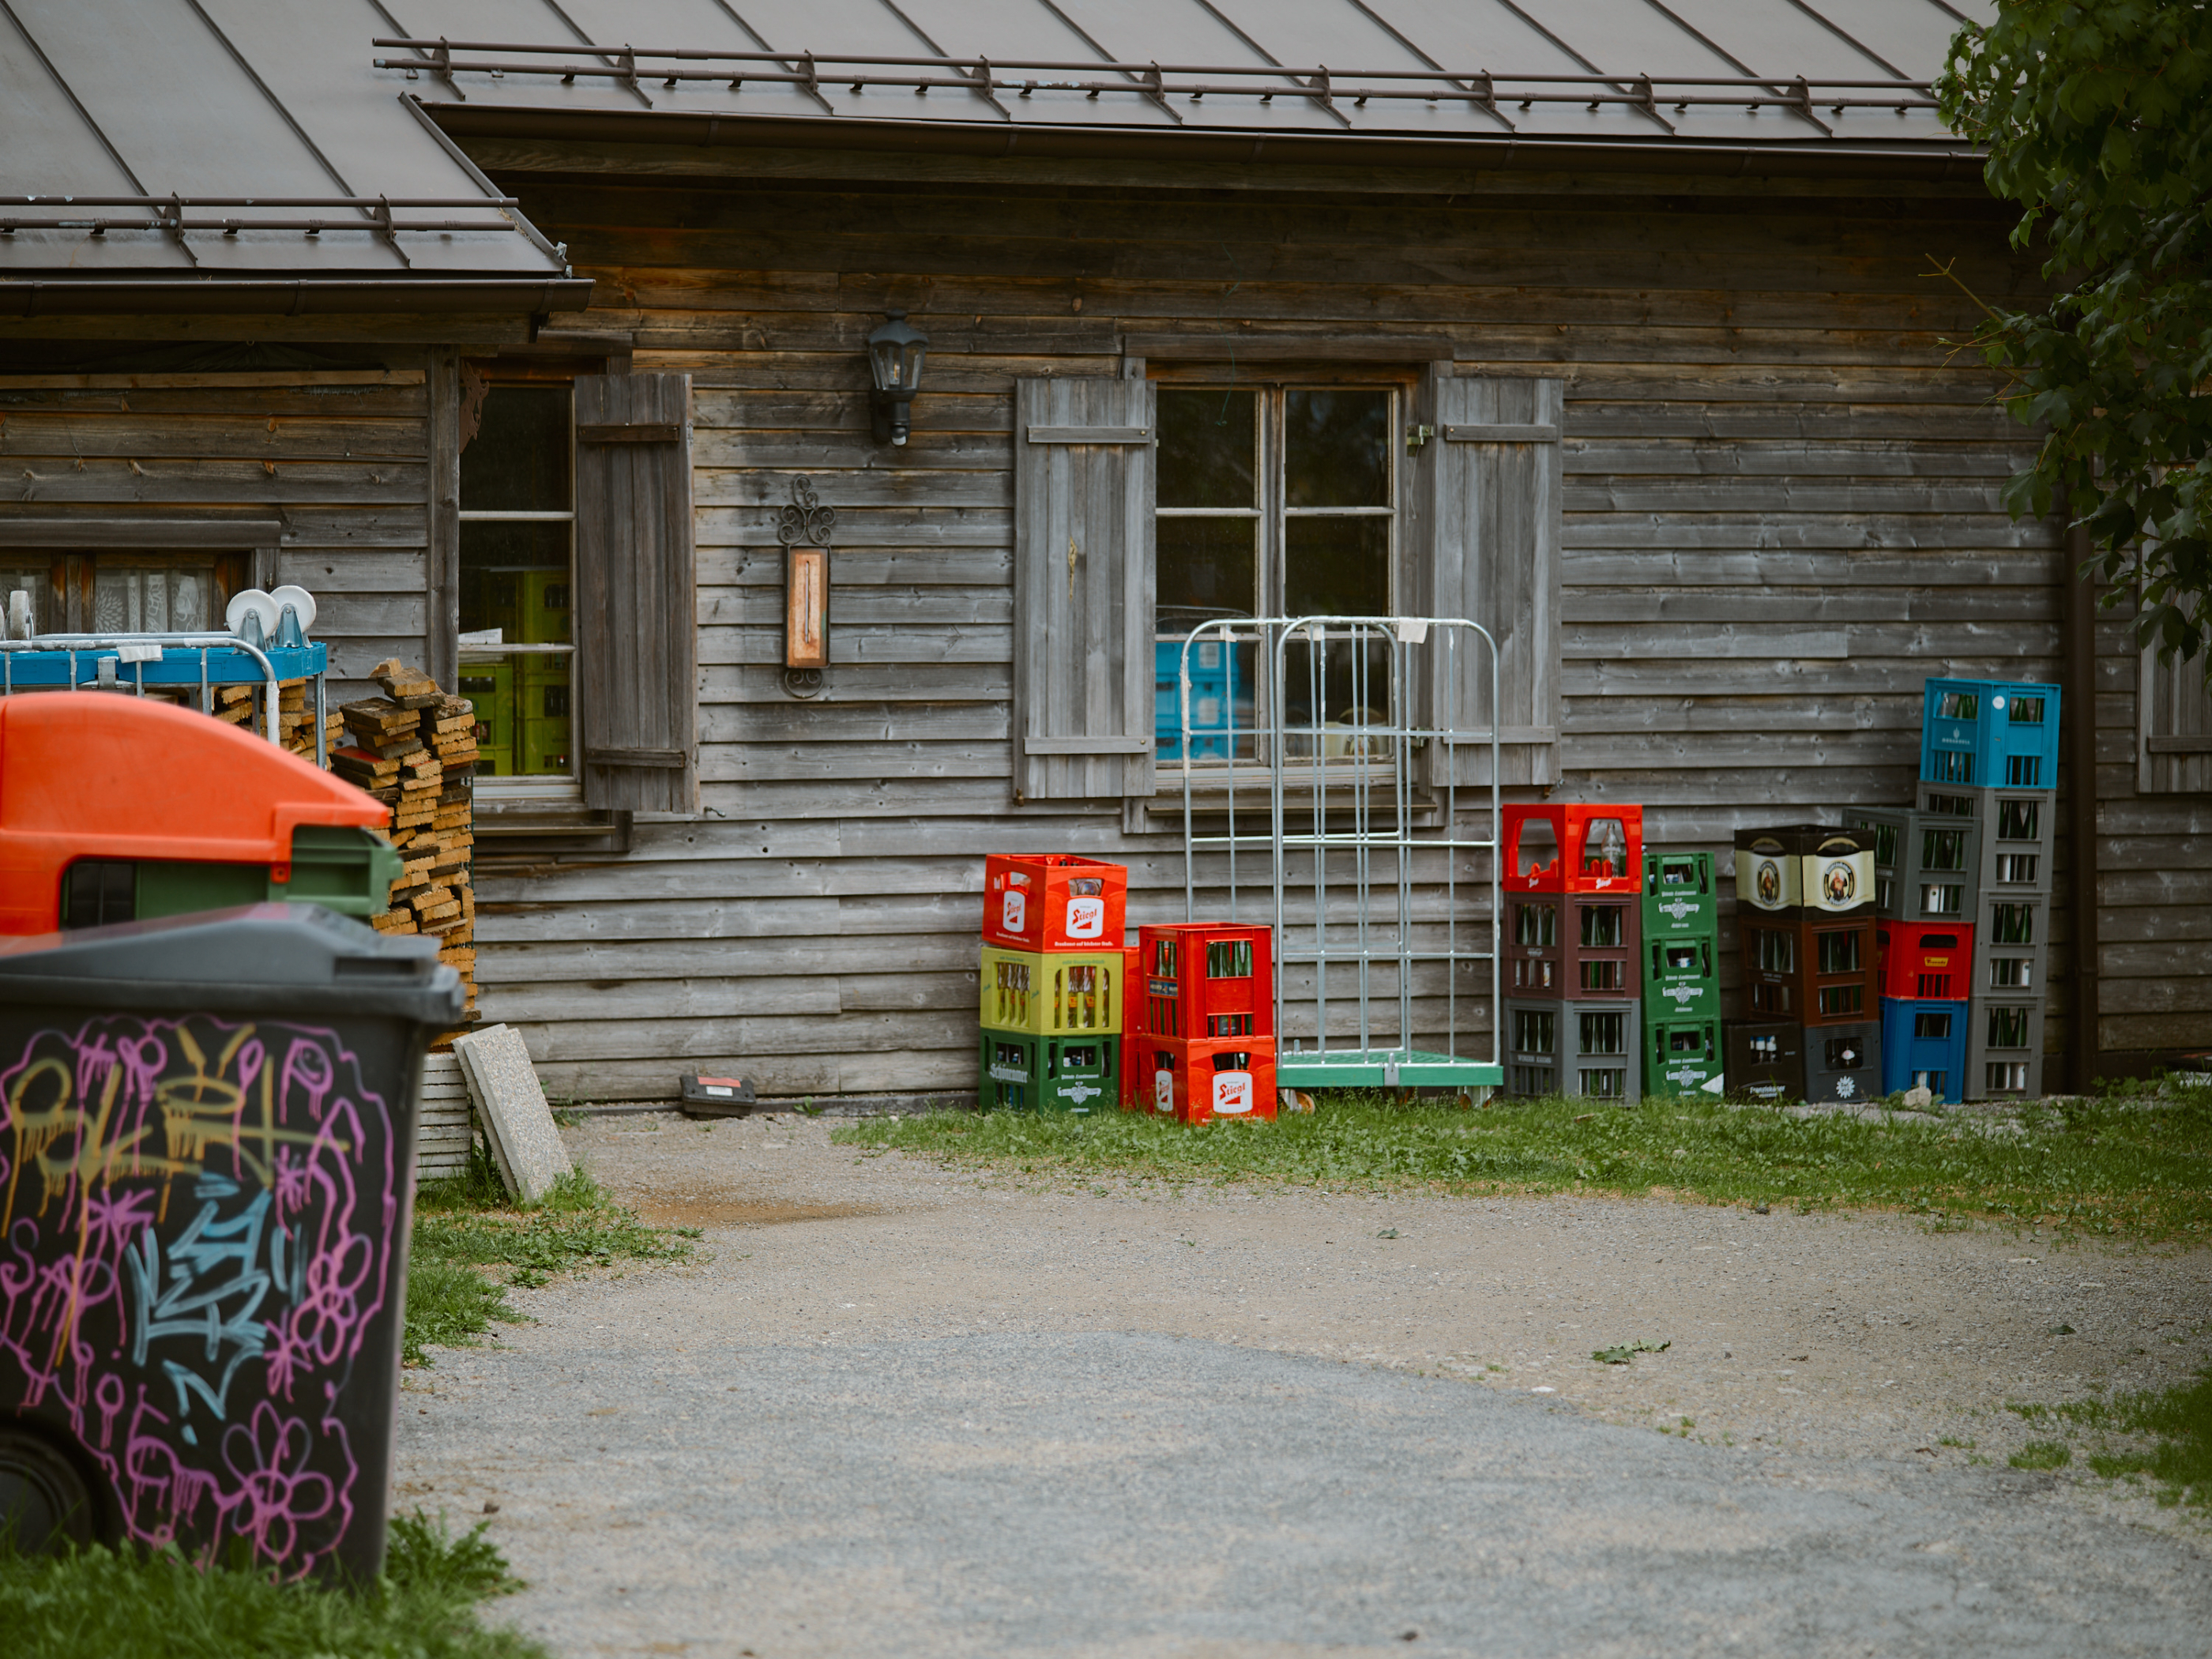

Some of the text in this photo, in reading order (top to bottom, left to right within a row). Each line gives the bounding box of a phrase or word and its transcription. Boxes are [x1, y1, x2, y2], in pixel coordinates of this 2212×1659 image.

[1006, 901, 1021, 917] Stiegl
[1072, 908, 1097, 925] Stiegl
[1219, 1082, 1246, 1100] Stiegl
